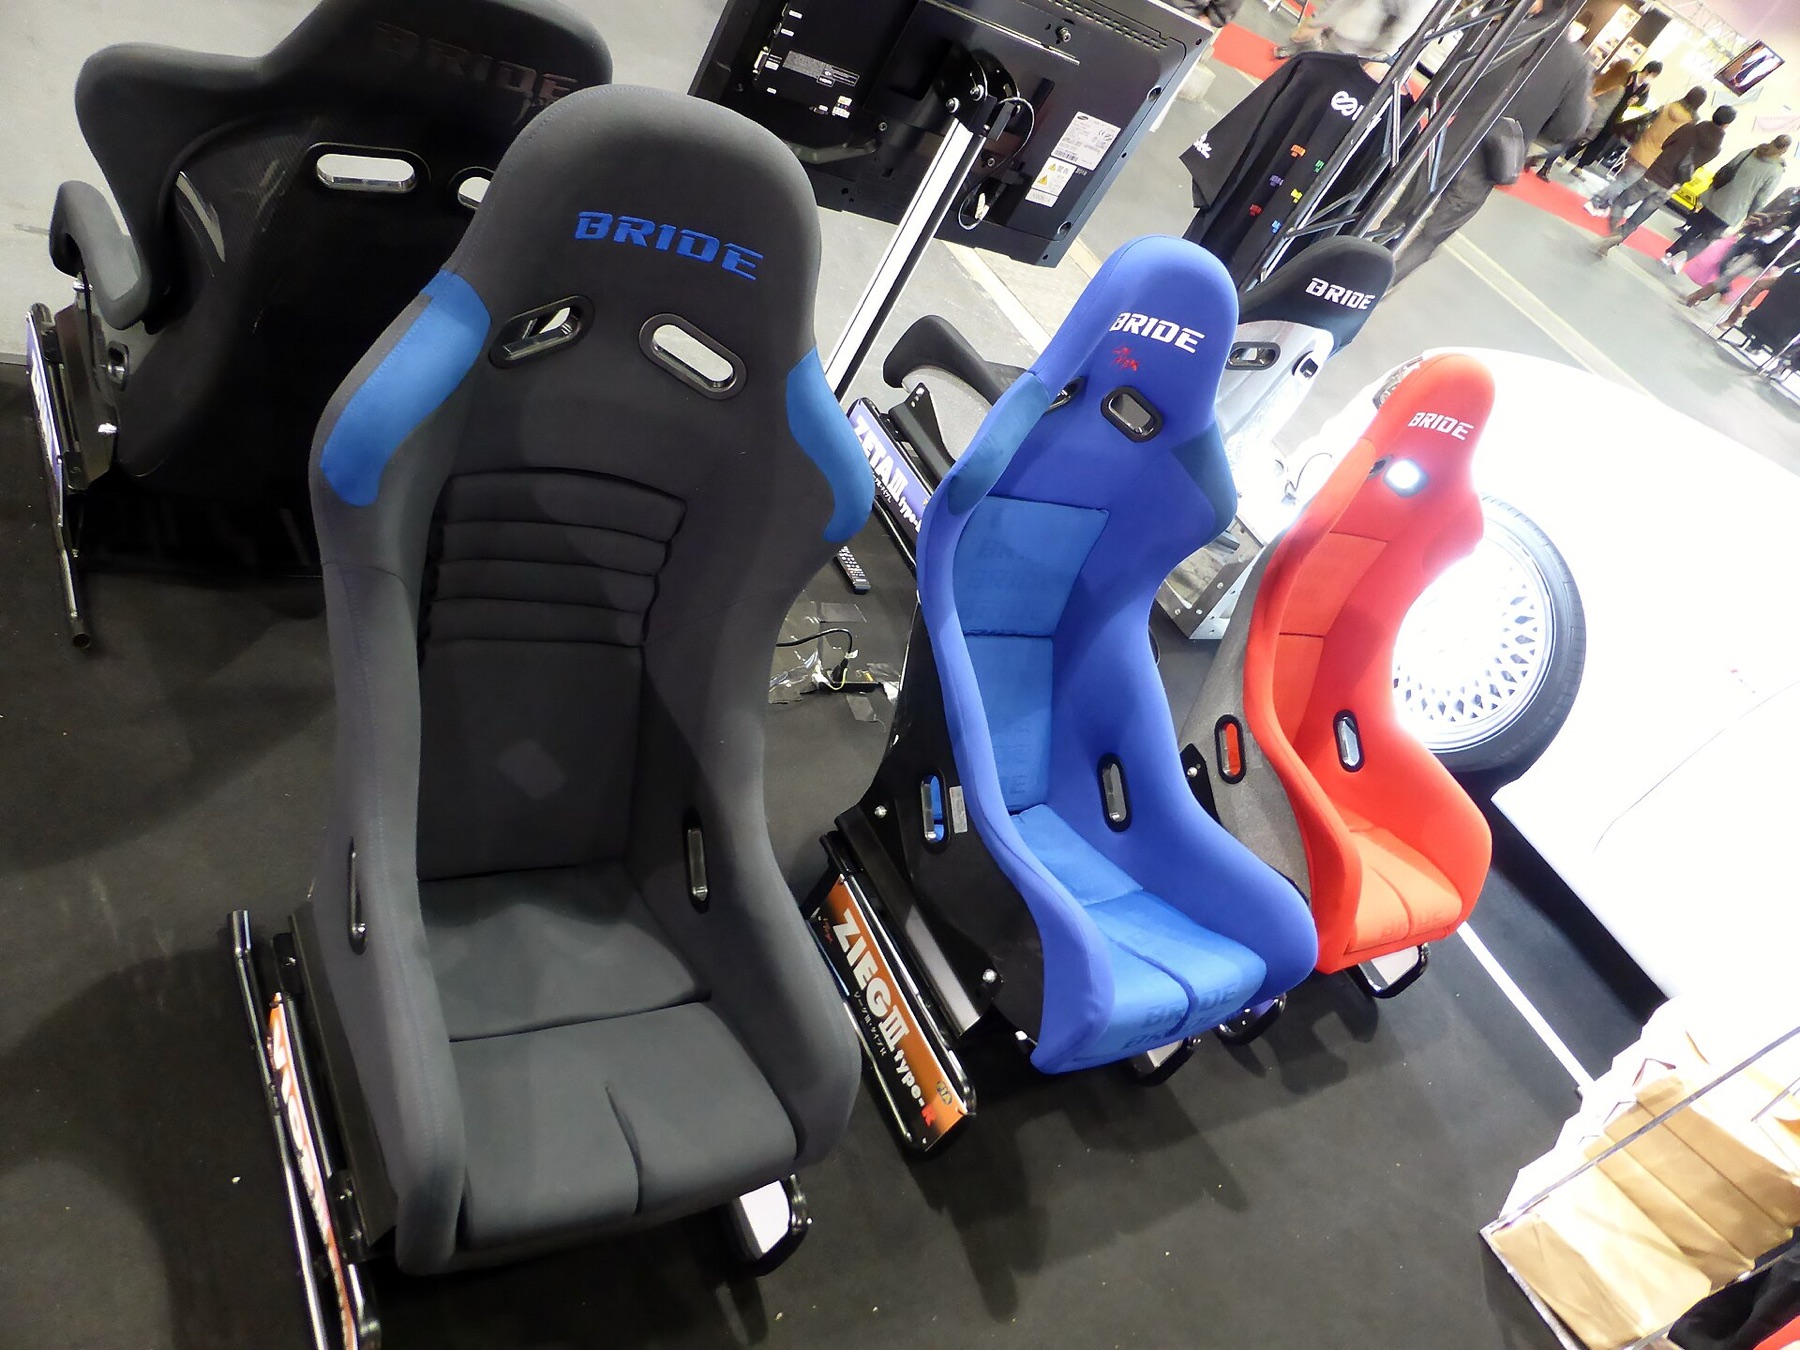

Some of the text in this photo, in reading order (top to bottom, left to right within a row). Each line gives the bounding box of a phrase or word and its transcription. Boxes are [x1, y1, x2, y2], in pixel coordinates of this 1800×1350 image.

[574, 211, 764, 281] BRIDE
[1306, 277, 1376, 310] BRIDE
[1109, 312, 1206, 354] BRIDE
[1407, 412, 1475, 441] BRIDE
